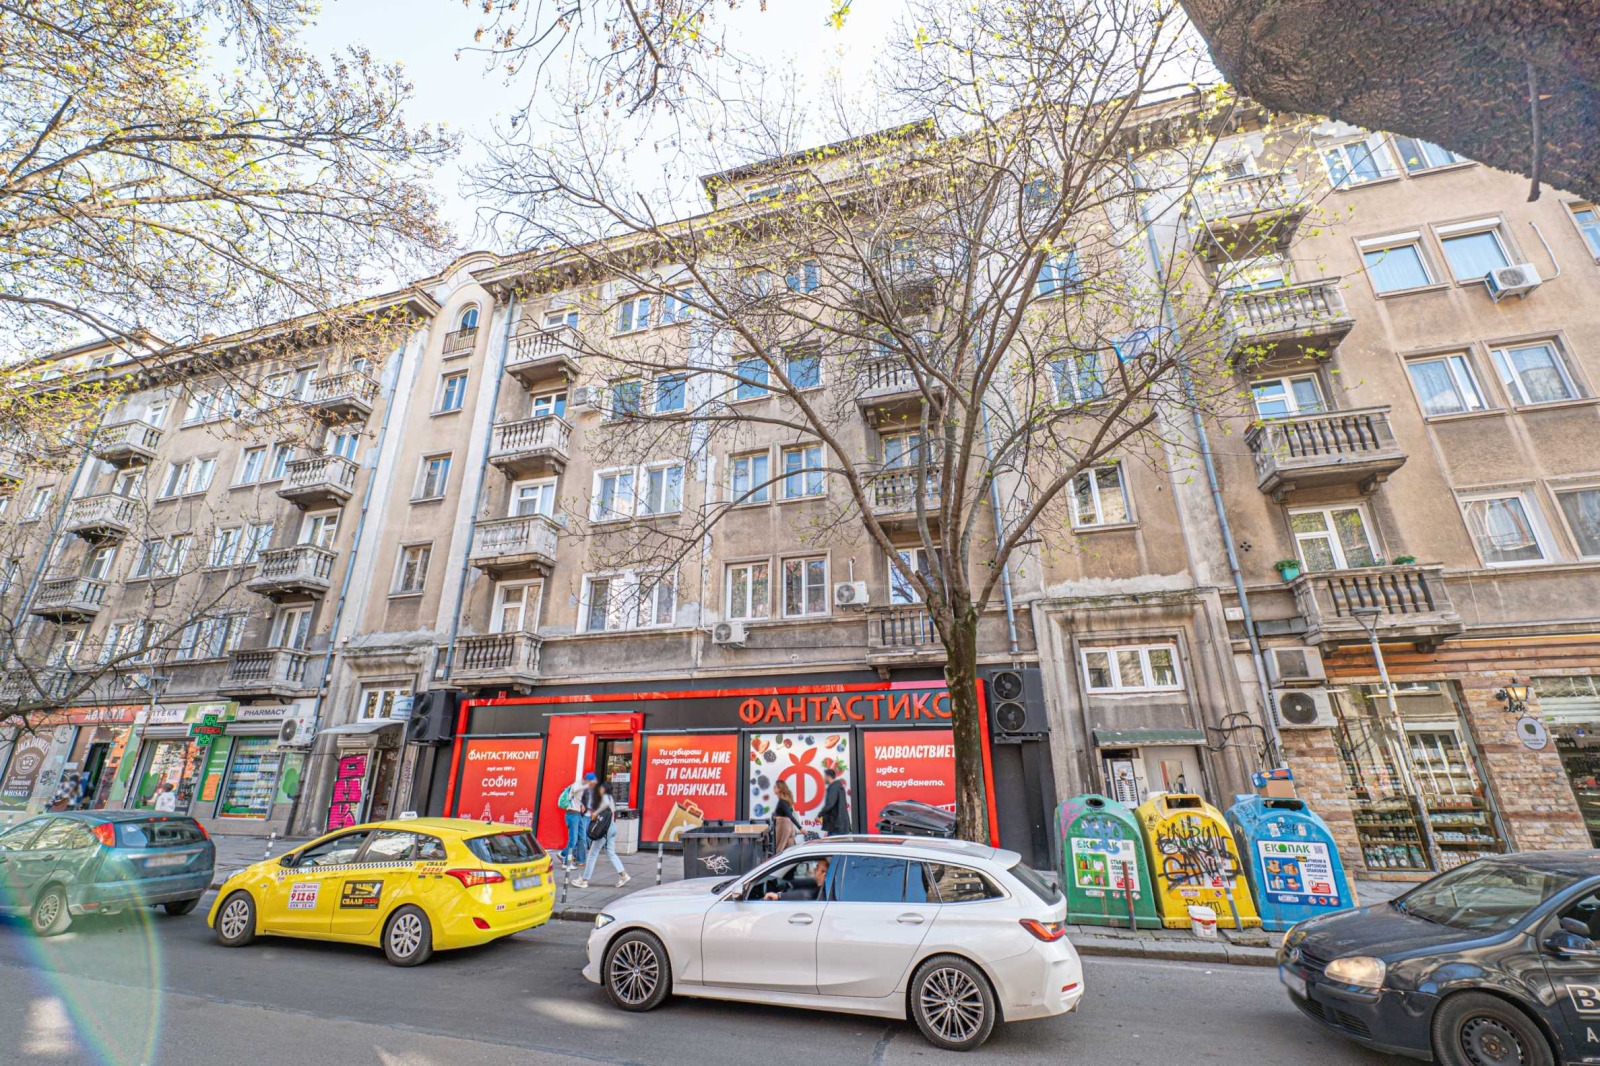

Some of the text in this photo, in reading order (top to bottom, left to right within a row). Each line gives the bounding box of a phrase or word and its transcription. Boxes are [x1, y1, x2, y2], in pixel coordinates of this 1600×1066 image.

[243, 708, 287, 716] PHARMACY
[738, 691, 953, 725] ФАНТАСТИКО
[467, 749, 525, 761] ФАНТАСТИКО
[668, 747, 703, 757] избираш
[702, 751, 732, 764] А НИЕ
[873, 744, 955, 760] УДОВОЛСТВИЕТ
[665, 767, 722, 780] ГИ СЛАГАМЕ
[876, 766, 898, 775] идва
[481, 775, 518, 788] СОФИЯ
[876, 779, 945, 788] пазаруването.
[656, 783, 728, 797] В ТОРБИЧКАТА.
